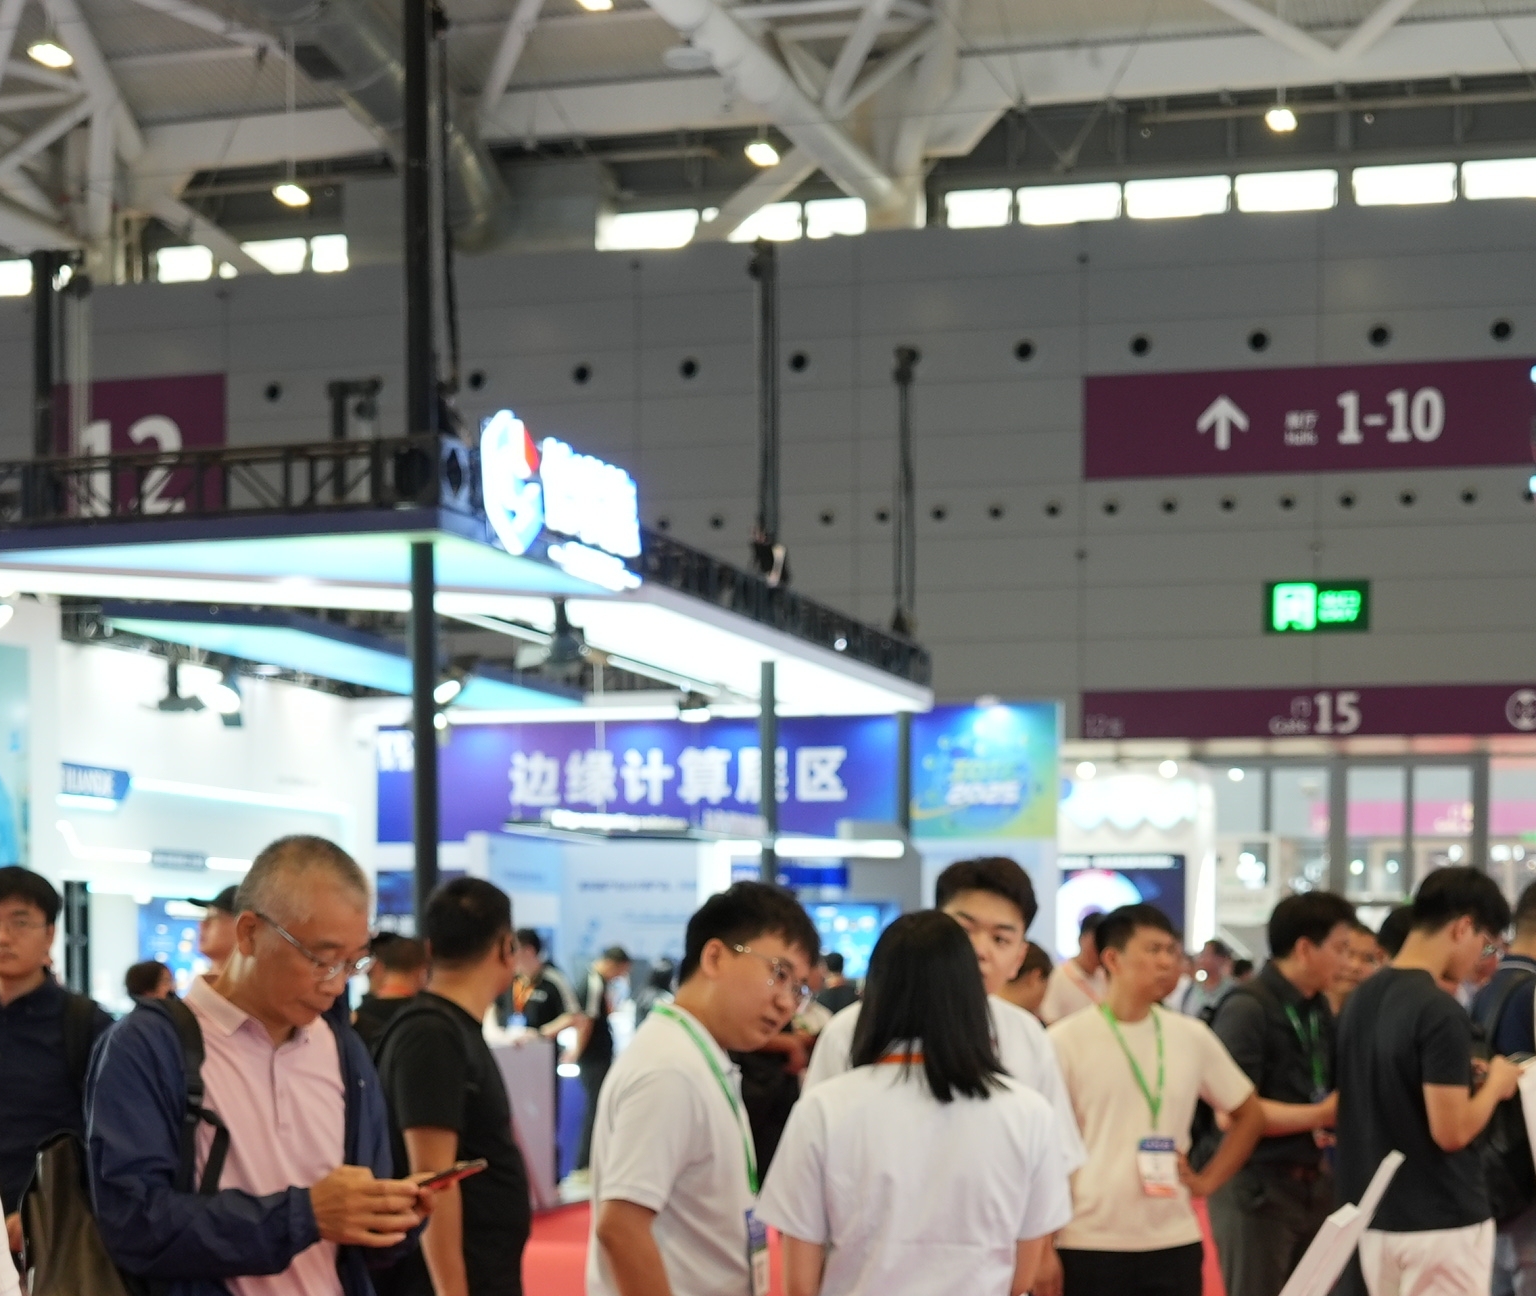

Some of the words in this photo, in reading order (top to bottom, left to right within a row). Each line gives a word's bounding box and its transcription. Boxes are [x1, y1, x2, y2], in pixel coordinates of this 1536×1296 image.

[1336, 386, 1446, 445] 1-10
[80, 414, 187, 517] 12
[1313, 690, 1362, 735] 15
[509, 746, 848, 806] 边缘计算展区
